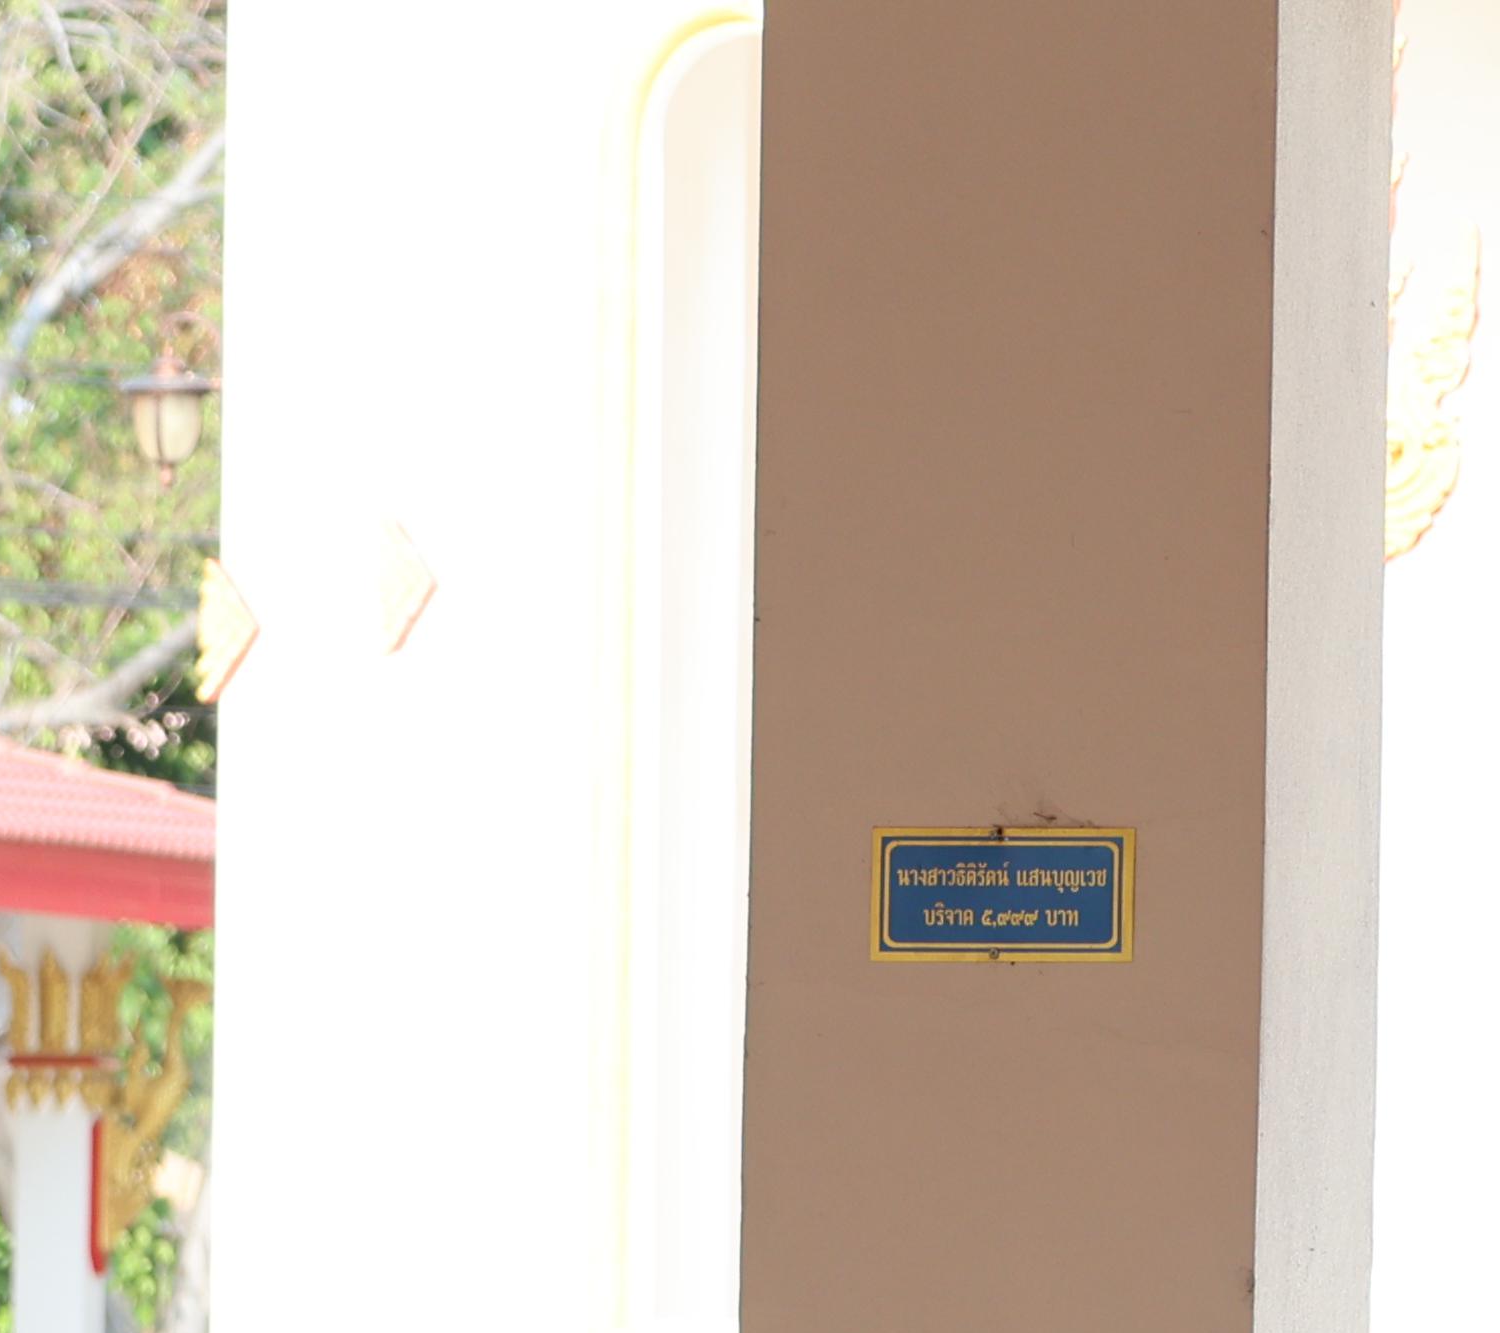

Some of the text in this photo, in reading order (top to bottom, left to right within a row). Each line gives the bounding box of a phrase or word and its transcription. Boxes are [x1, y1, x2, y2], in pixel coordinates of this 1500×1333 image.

[1016, 868, 1107, 892] แสนบุญเวช
[924, 902, 1079, 928] บริจาค ๕,๙๙๙ บาท
